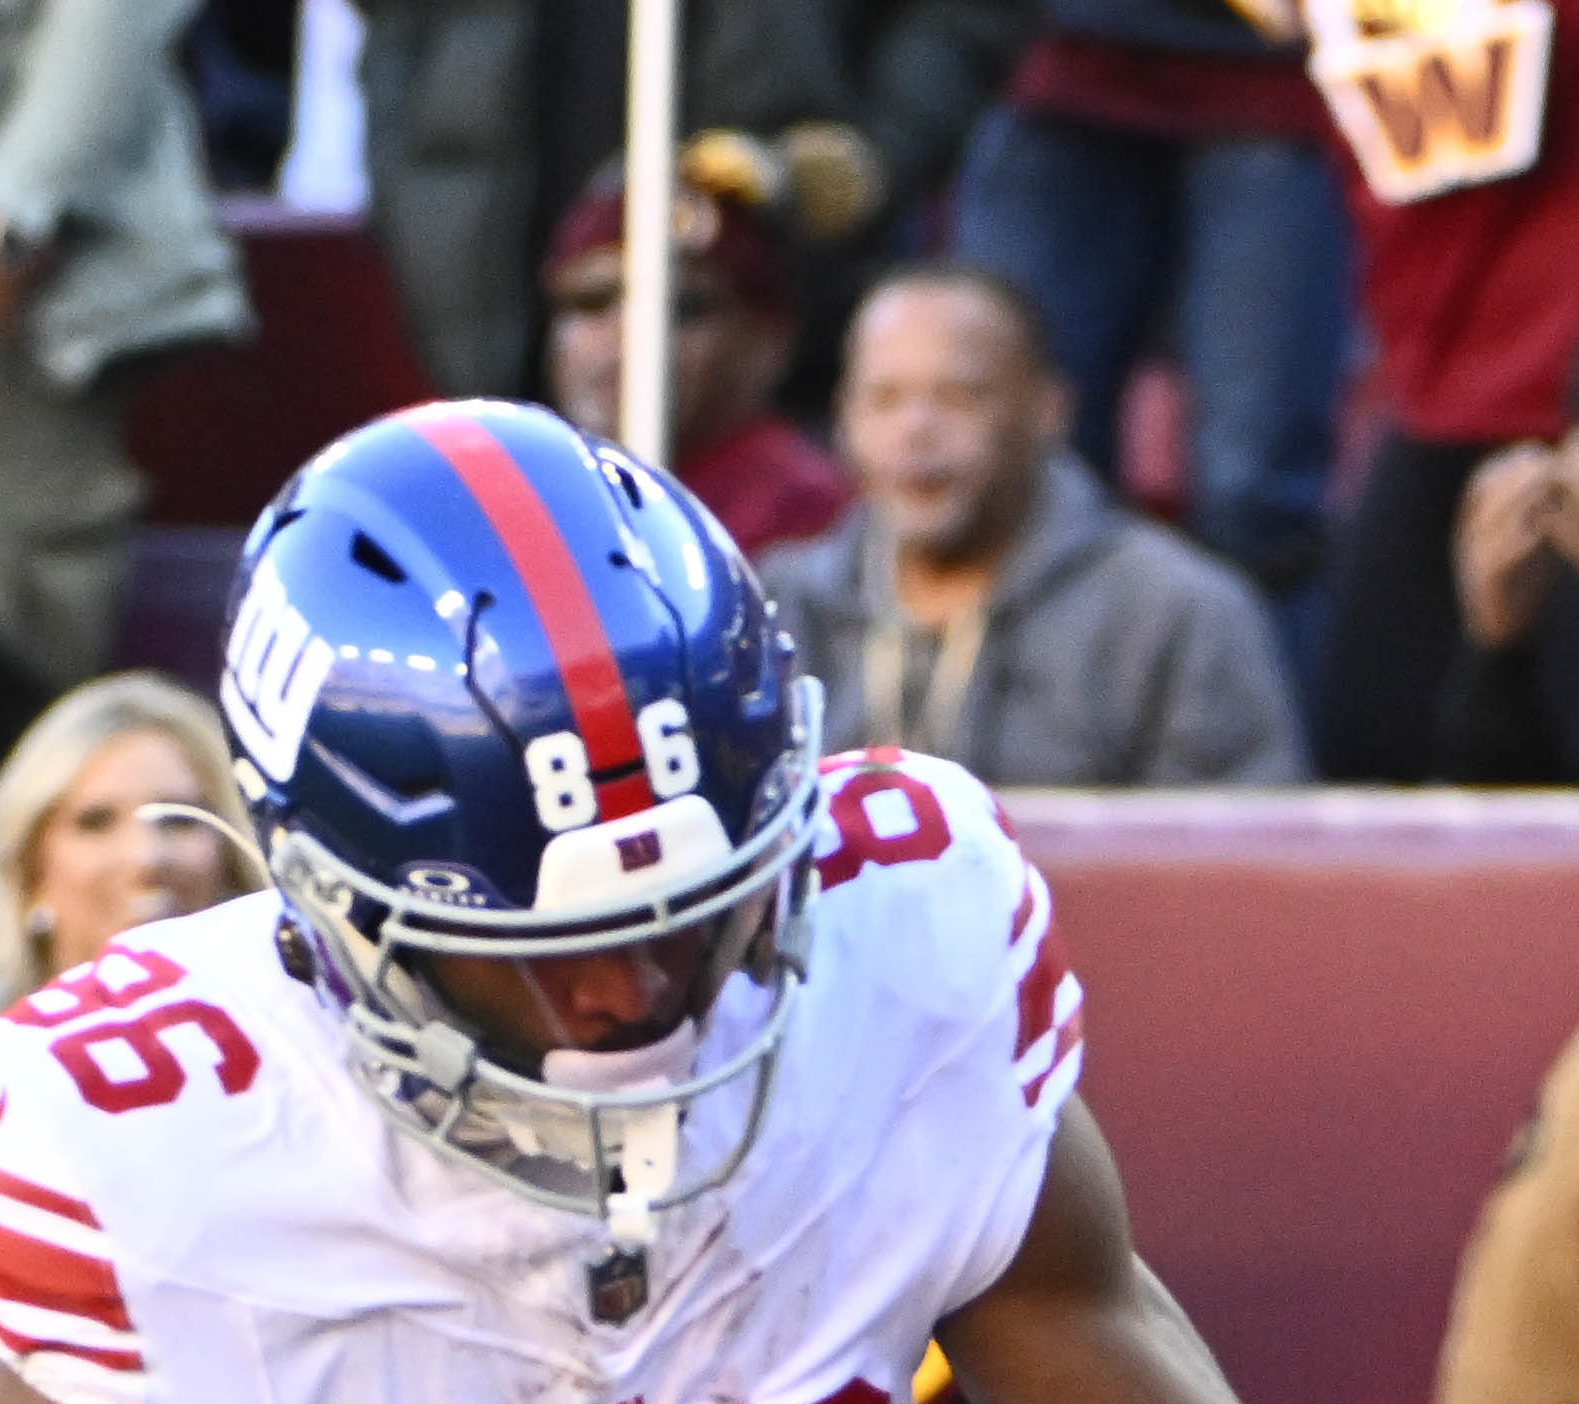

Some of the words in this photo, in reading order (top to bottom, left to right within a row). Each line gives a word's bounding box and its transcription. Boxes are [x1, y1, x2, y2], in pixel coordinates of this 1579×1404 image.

[1353, 33, 1520, 175] W
[524, 698, 702, 834] 86
[0, 944, 263, 1115] 86
